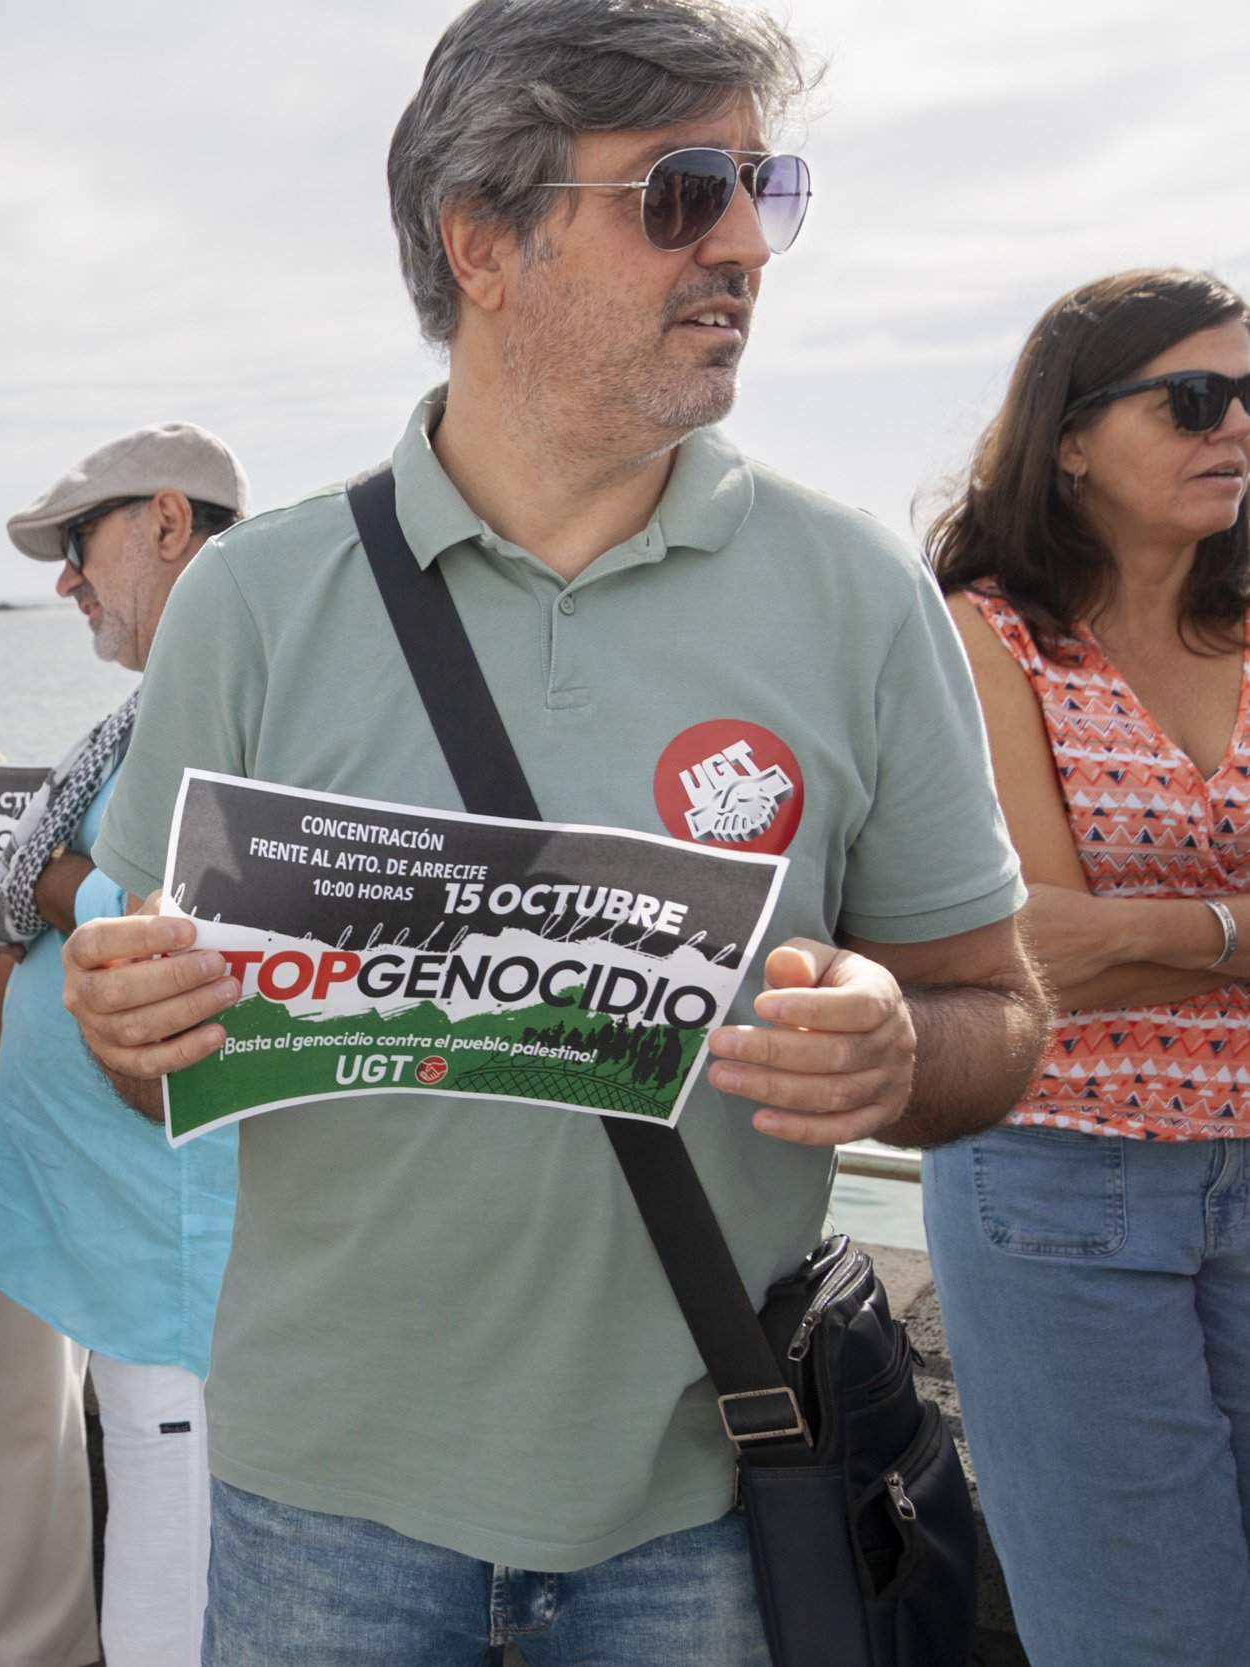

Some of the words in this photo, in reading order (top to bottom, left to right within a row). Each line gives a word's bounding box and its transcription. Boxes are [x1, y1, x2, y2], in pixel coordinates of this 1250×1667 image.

[678, 739, 762, 807] UGT
[301, 815, 444, 851] CONCENTRACIÓN
[249, 837, 308, 864] FRENTE
[310, 848, 332, 868] AL
[335, 852, 381, 874] AYTO.
[386, 858, 408, 876] DE
[410, 861, 488, 880] ARRECIFE
[313, 879, 354, 898] 10:00
[358, 883, 414, 901] HORAS
[444, 883, 484, 914] 15
[488, 884, 688, 935] OCTUBRE
[220, 950, 717, 1030] TOPGENOCIDIO
[274, 1033, 290, 1049] al
[292, 1032, 374, 1052] genocidio
[376, 1033, 430, 1048] contra
[434, 1034, 450, 1049] el
[450, 1036, 509, 1052] pueblo
[510, 1042, 598, 1063] palestino!
[335, 1054, 413, 1085] UGT
